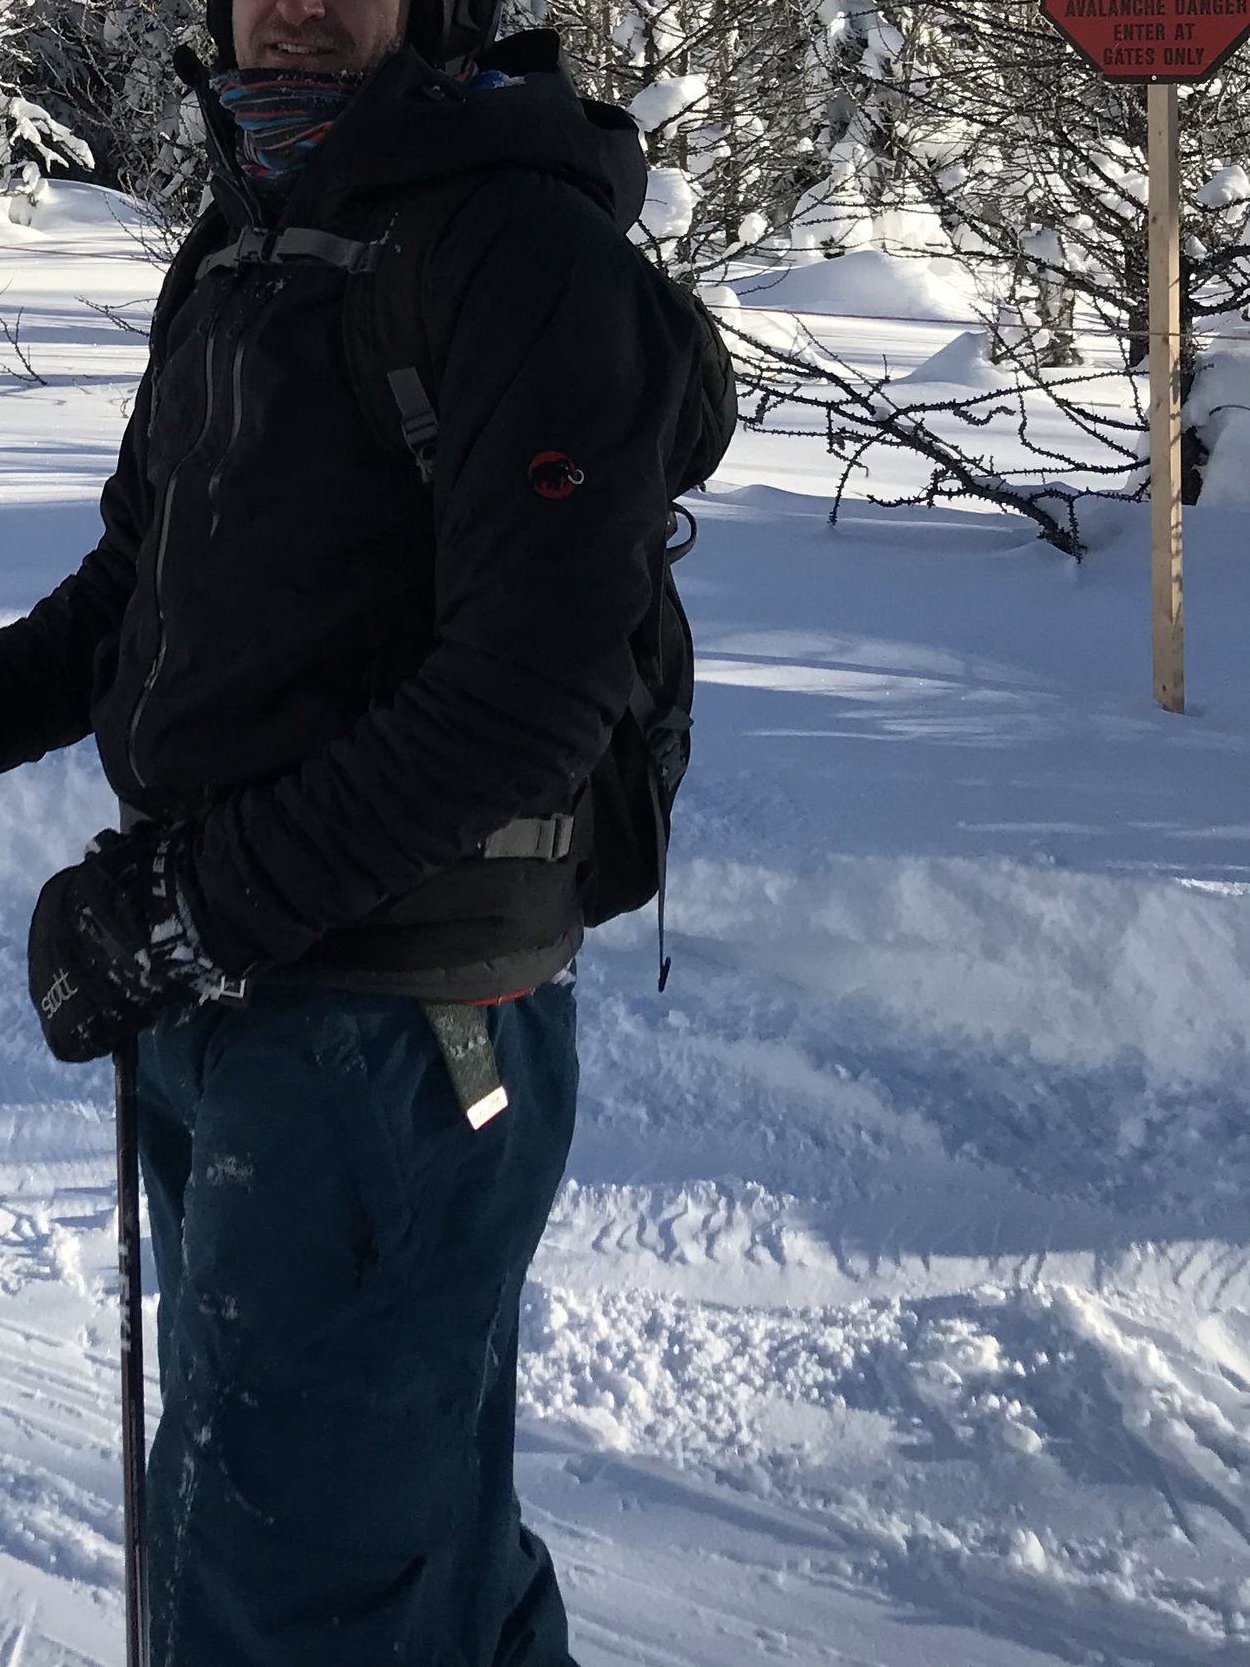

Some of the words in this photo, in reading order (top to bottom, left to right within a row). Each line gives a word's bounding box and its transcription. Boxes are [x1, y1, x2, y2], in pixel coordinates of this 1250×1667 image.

[1113, 23, 1166, 42] ENTER
[1174, 22, 1196, 41] AT
[1103, 47, 1155, 66] GATES
[1164, 47, 1205, 66] ONLY
